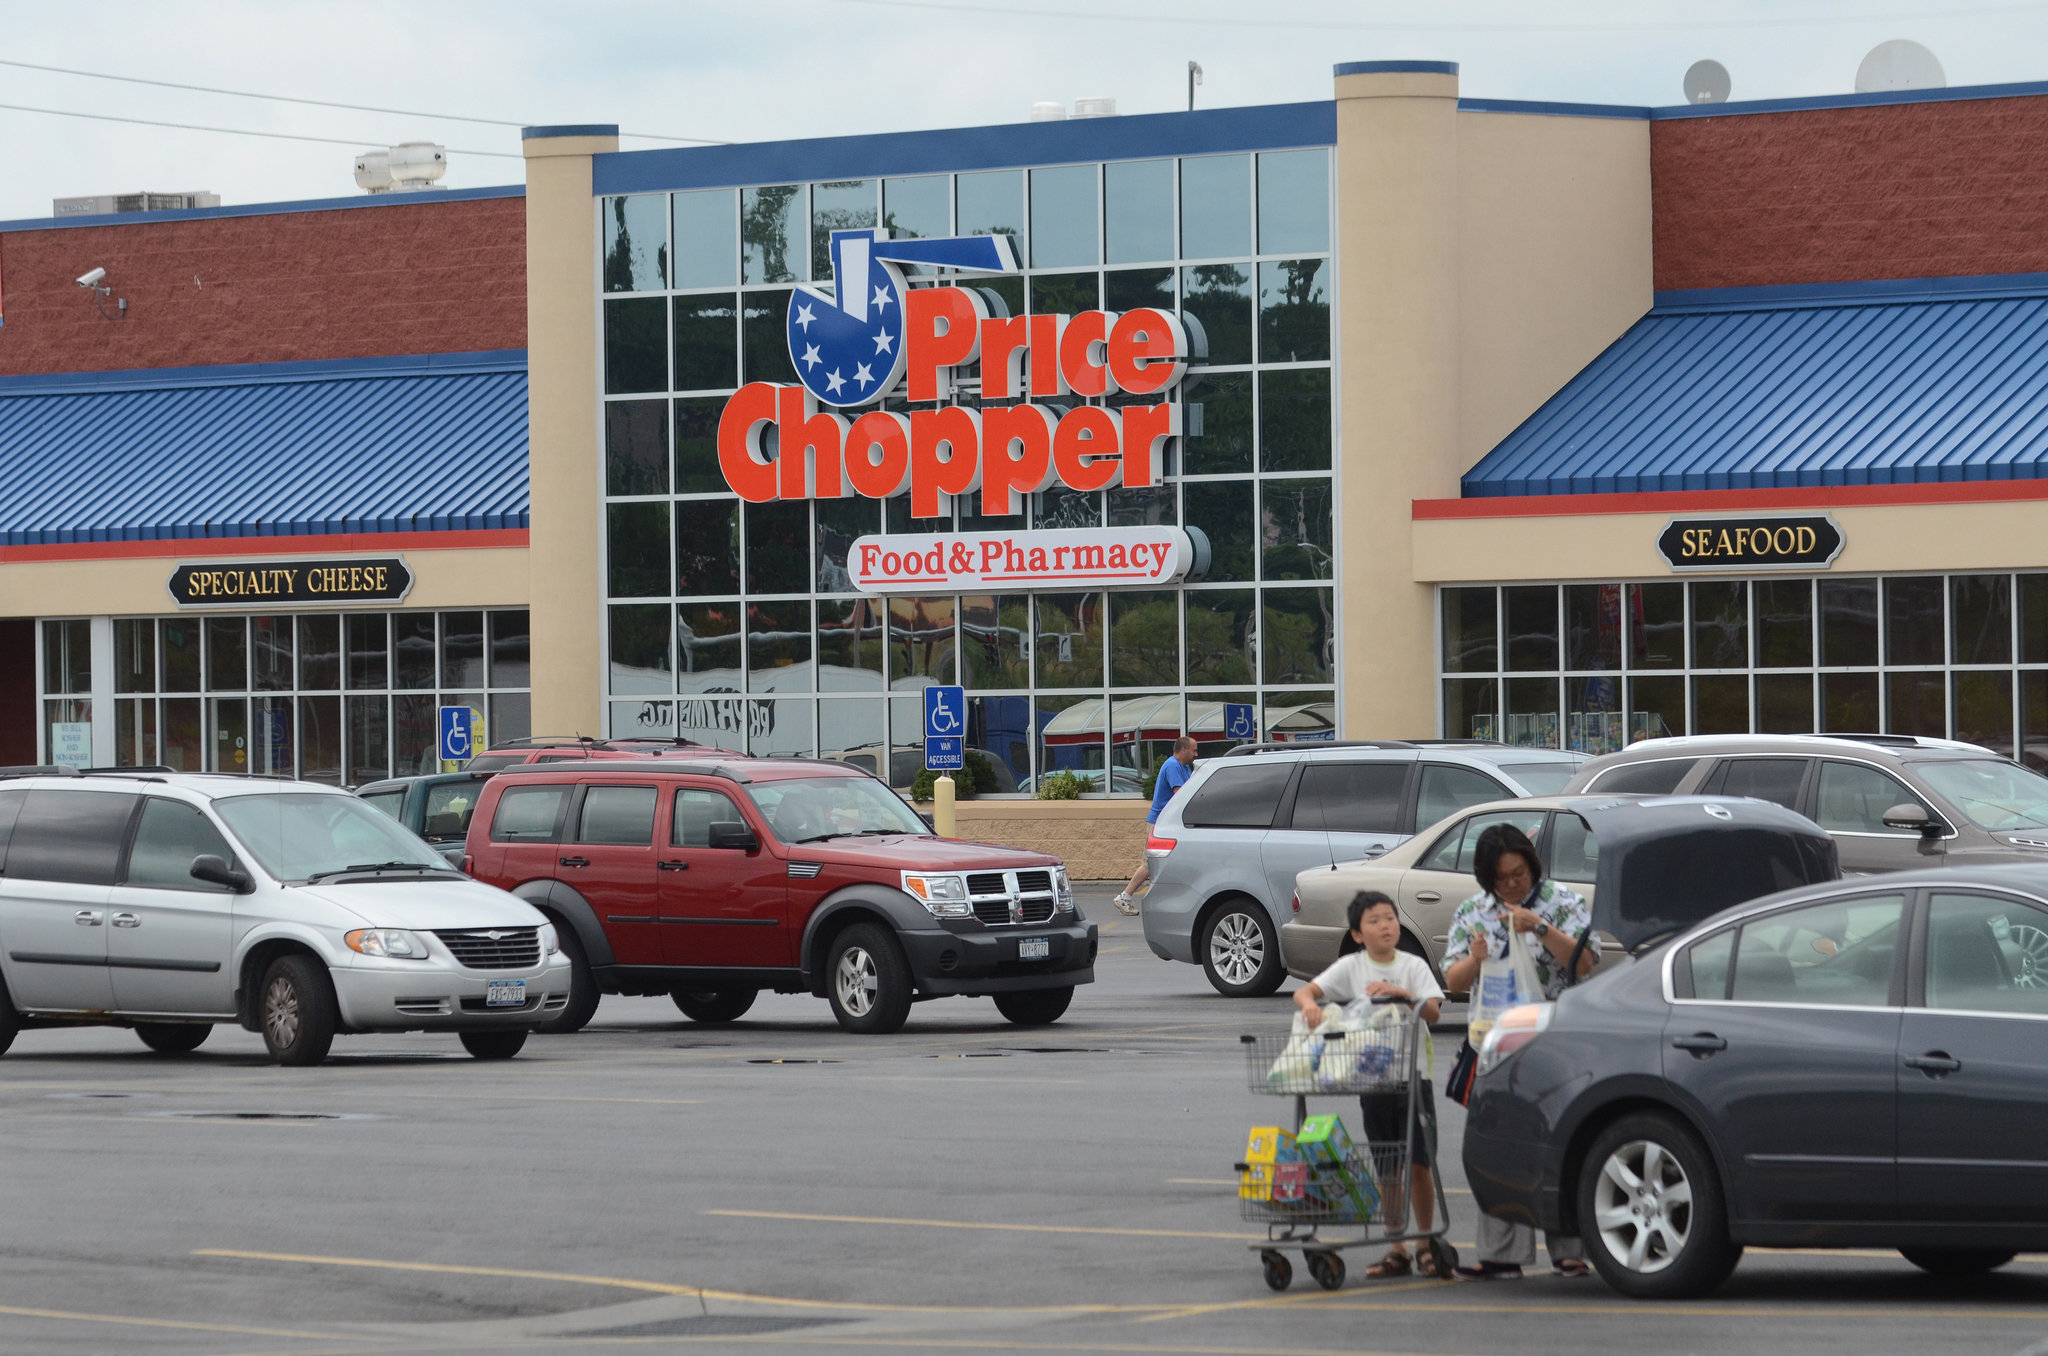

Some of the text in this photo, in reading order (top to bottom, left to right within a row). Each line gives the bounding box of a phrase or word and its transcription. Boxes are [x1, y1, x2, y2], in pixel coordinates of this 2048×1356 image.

[906, 286, 1186, 402] Price
[717, 381, 1183, 518] Chopper
[1682, 526, 1817, 557] SEAFOOD
[188, 566, 388, 597] SPECIALTY CHEESE
[928, 754, 961, 764] ACCESSIBLE
[940, 742, 952, 751] VAN
